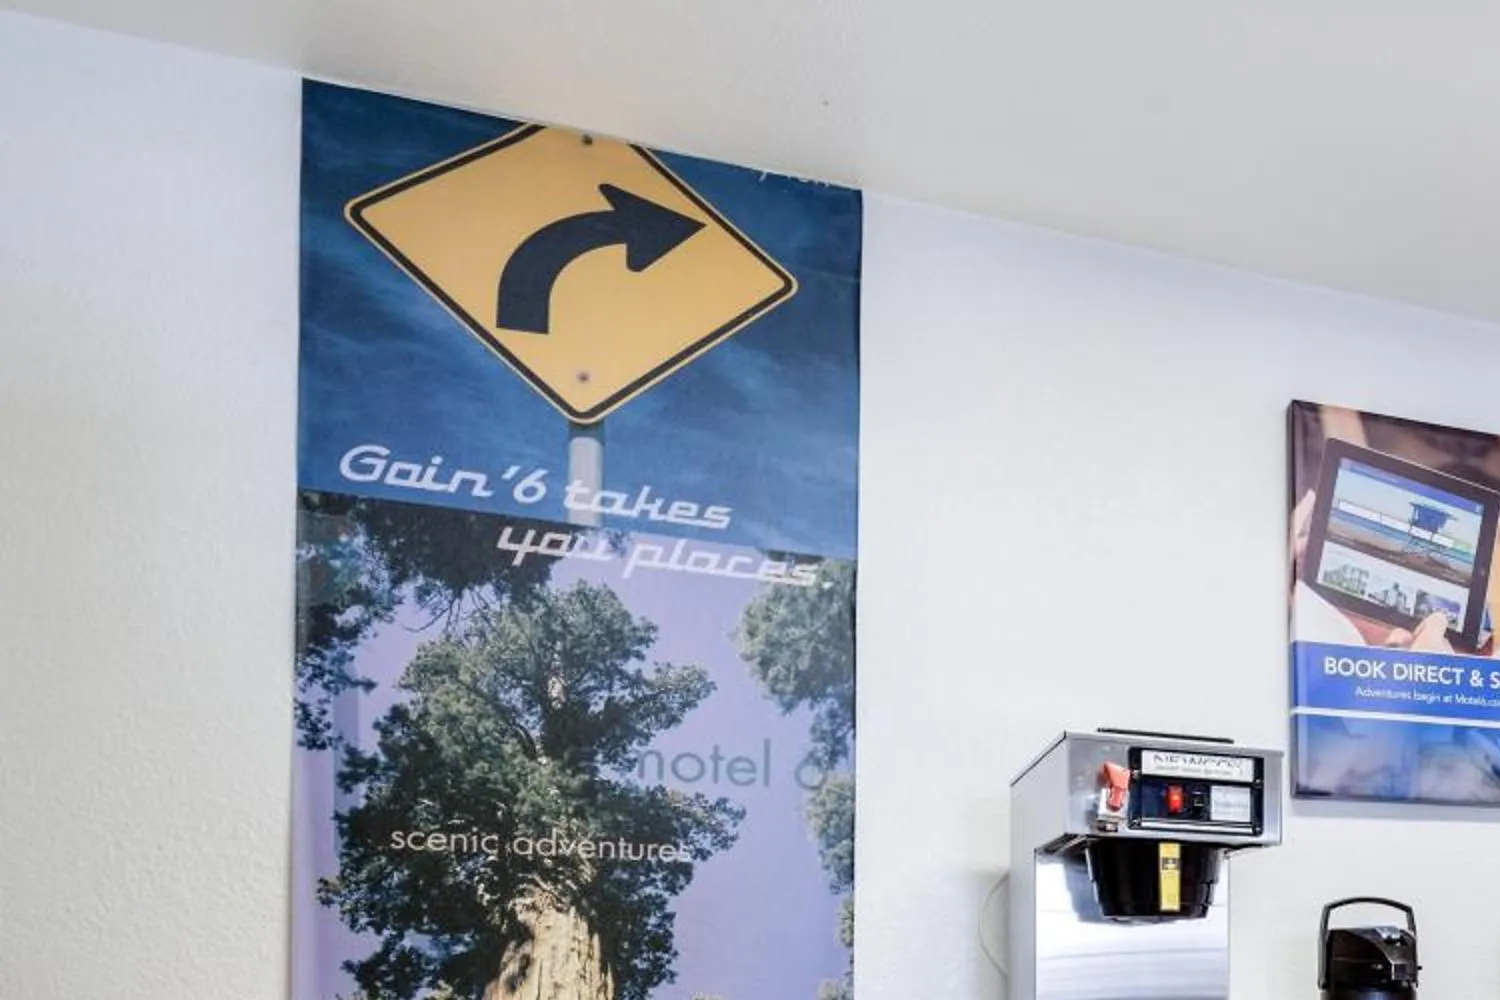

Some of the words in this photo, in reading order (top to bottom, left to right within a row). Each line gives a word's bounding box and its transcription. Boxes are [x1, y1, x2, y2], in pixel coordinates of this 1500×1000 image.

[564, 479, 735, 529] takes
[497, 526, 613, 565] you
[622, 532, 833, 590] places.
[1323, 656, 1387, 680] BOOK
[1393, 663, 1465, 687] DIRECT
[1469, 669, 1485, 689] &
[390, 826, 499, 855] scenic
[513, 828, 691, 863] adventures
